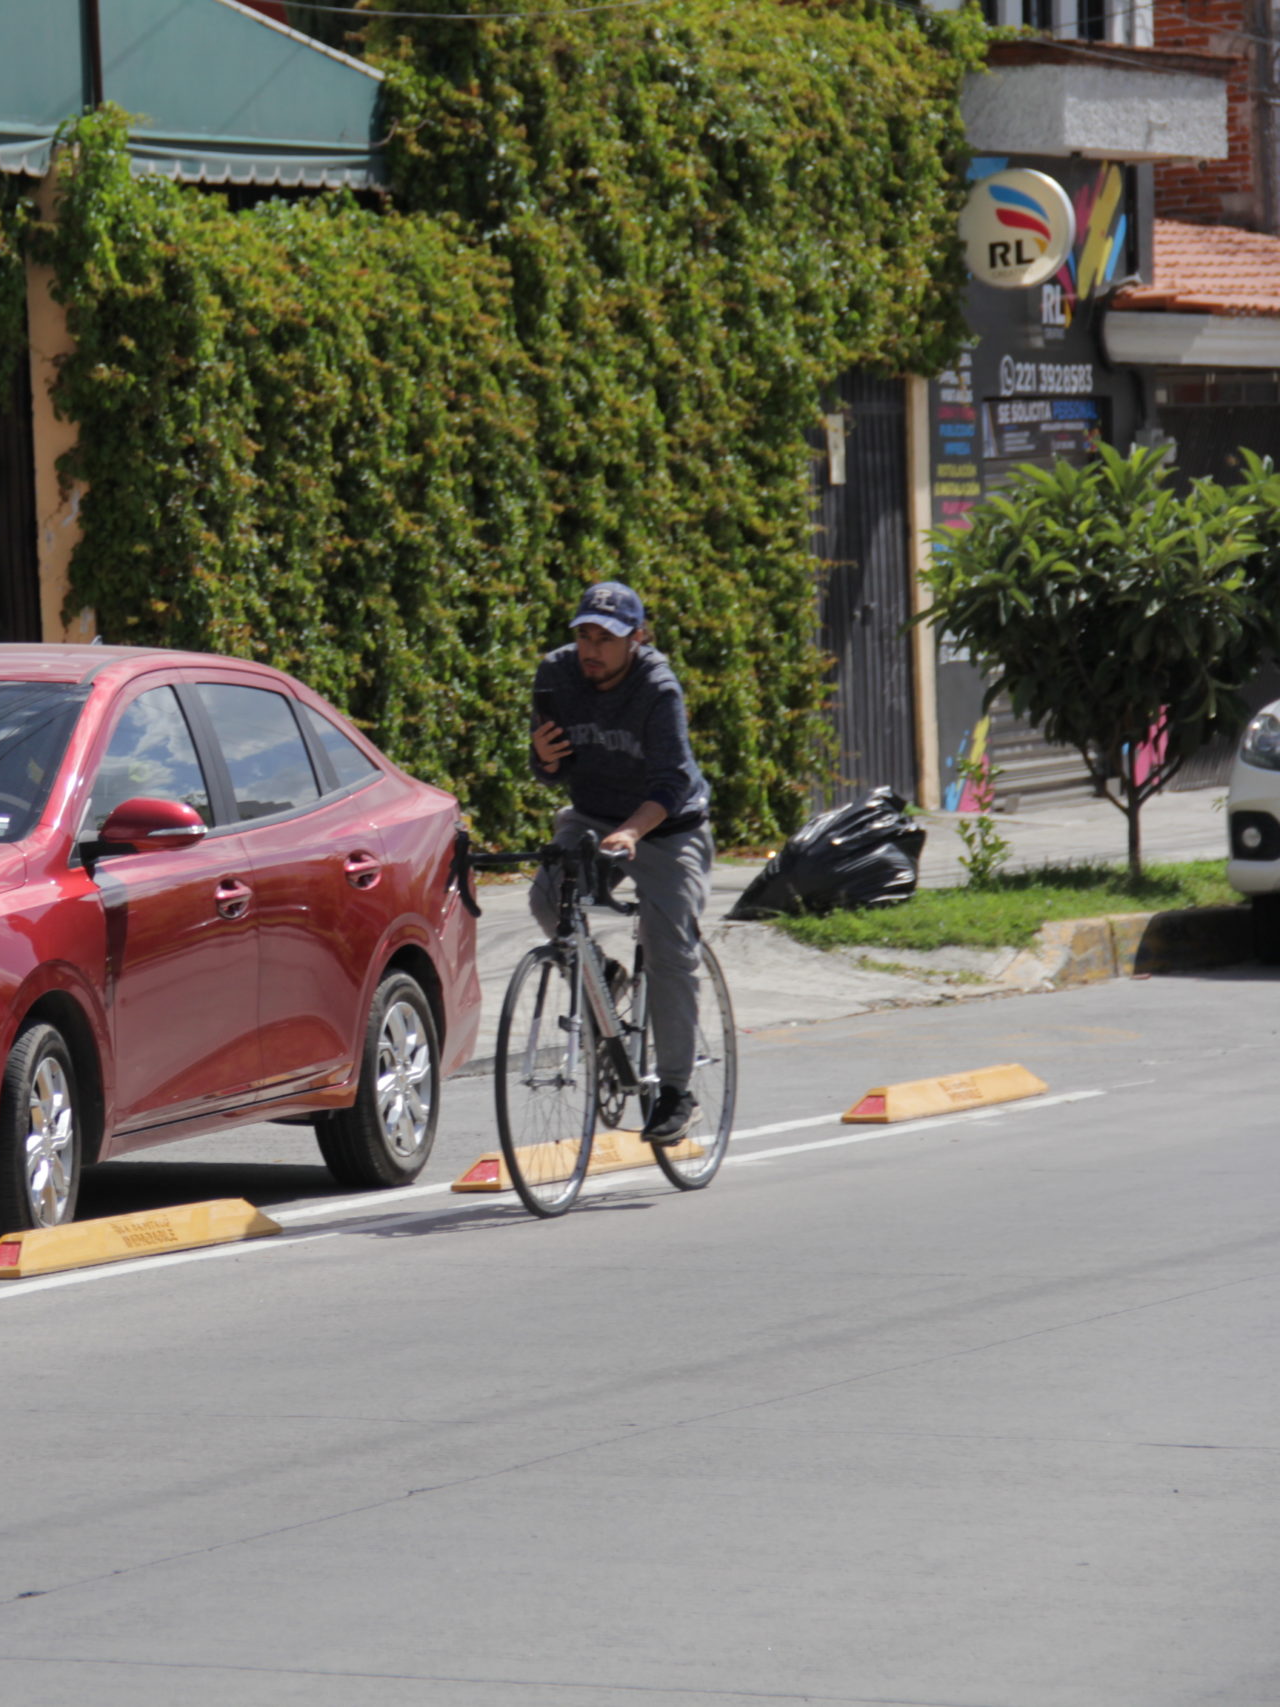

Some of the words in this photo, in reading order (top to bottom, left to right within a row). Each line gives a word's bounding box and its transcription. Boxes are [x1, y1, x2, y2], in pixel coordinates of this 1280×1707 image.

[989, 239, 1035, 269] RL
[1042, 284, 1066, 324] RL
[1015, 363, 1036, 392] 221
